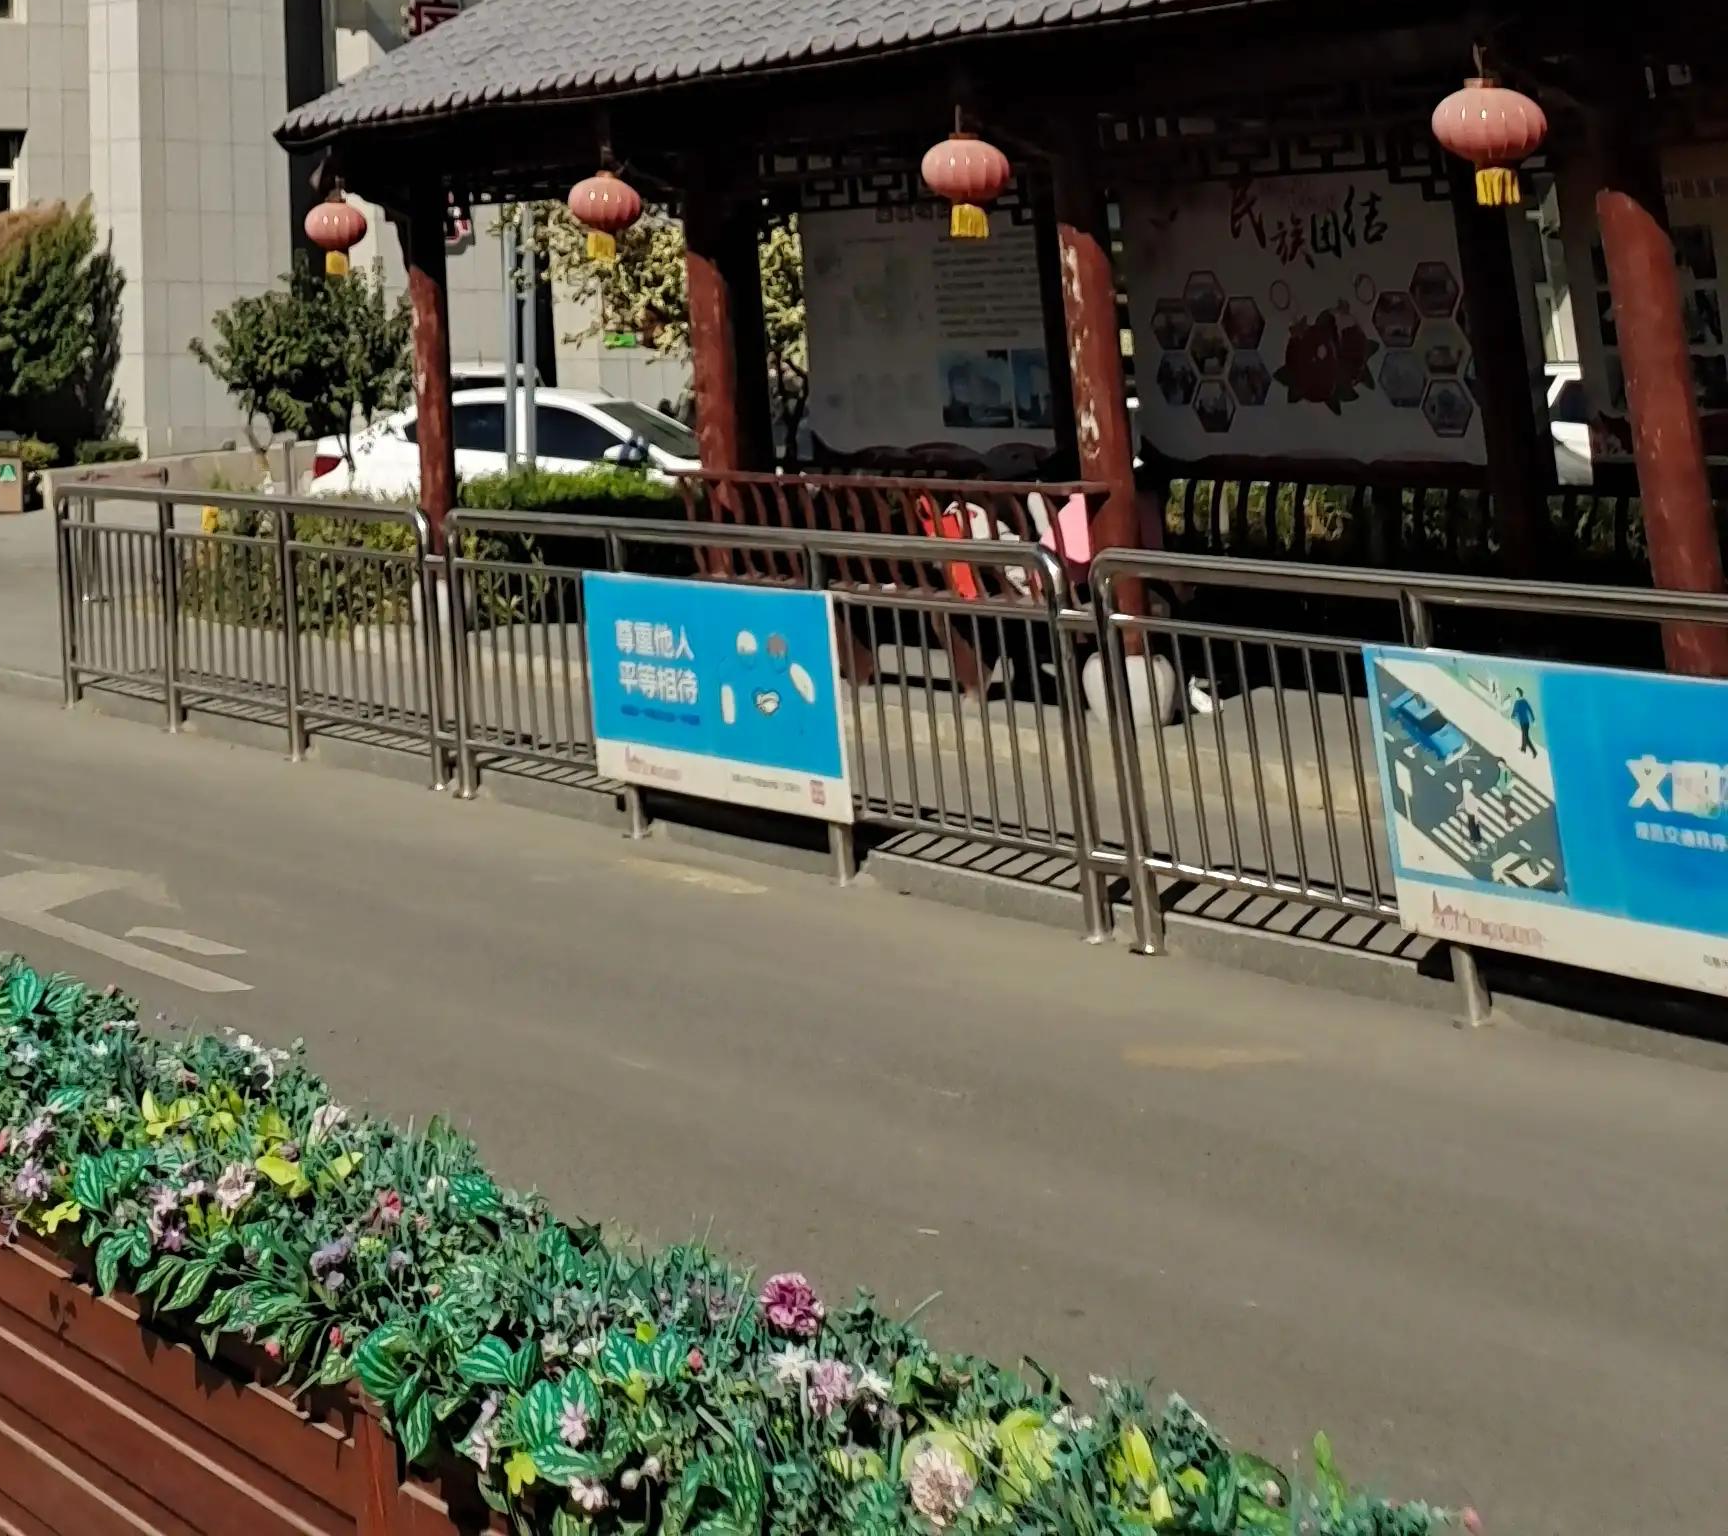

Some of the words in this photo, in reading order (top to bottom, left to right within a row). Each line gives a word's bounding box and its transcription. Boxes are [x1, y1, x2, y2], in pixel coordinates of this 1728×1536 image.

[1229, 180, 1388, 269] 民族团结
[615, 618, 695, 661] 尊重他人
[619, 660, 700, 705] 平等相待
